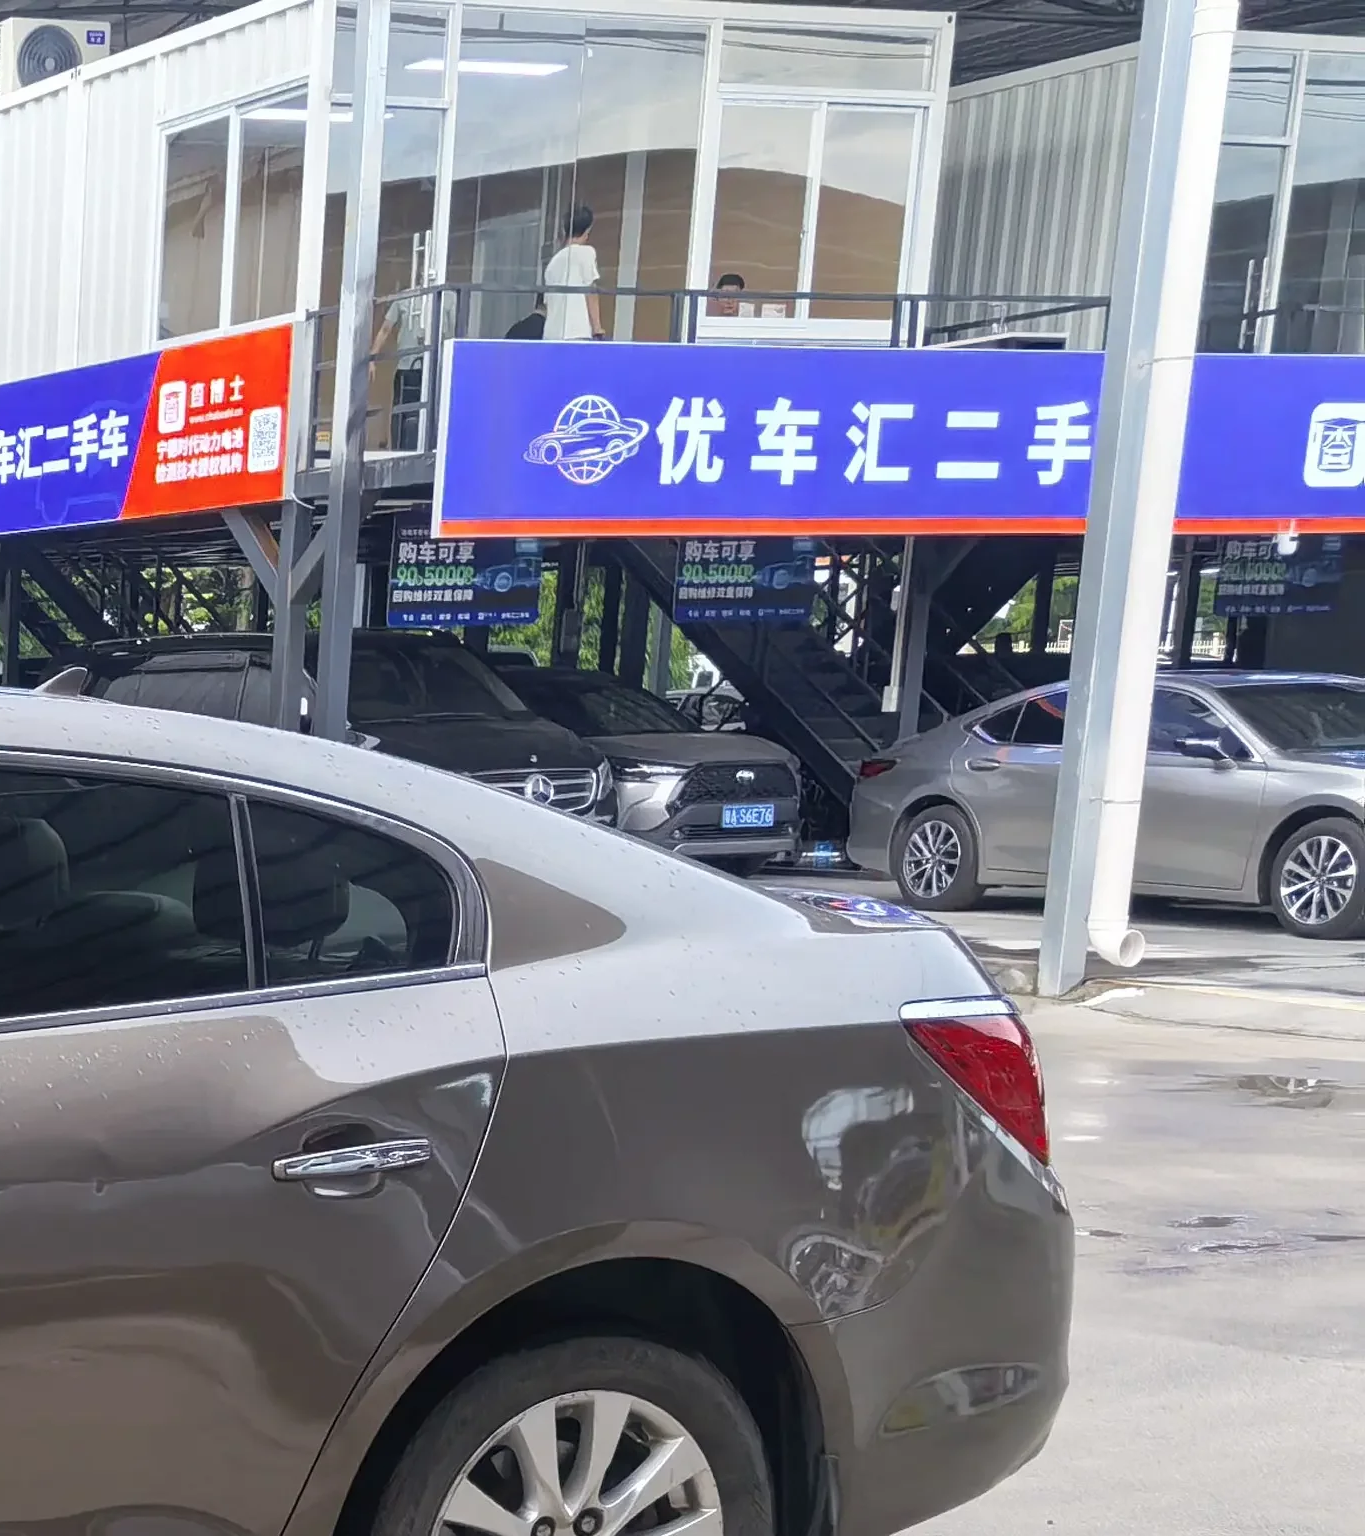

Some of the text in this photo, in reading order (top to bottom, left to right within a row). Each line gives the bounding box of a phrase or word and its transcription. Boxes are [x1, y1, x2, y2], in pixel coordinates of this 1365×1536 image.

[398, 541, 475, 564] 购车可享
[684, 540, 757, 562] 购车可享
